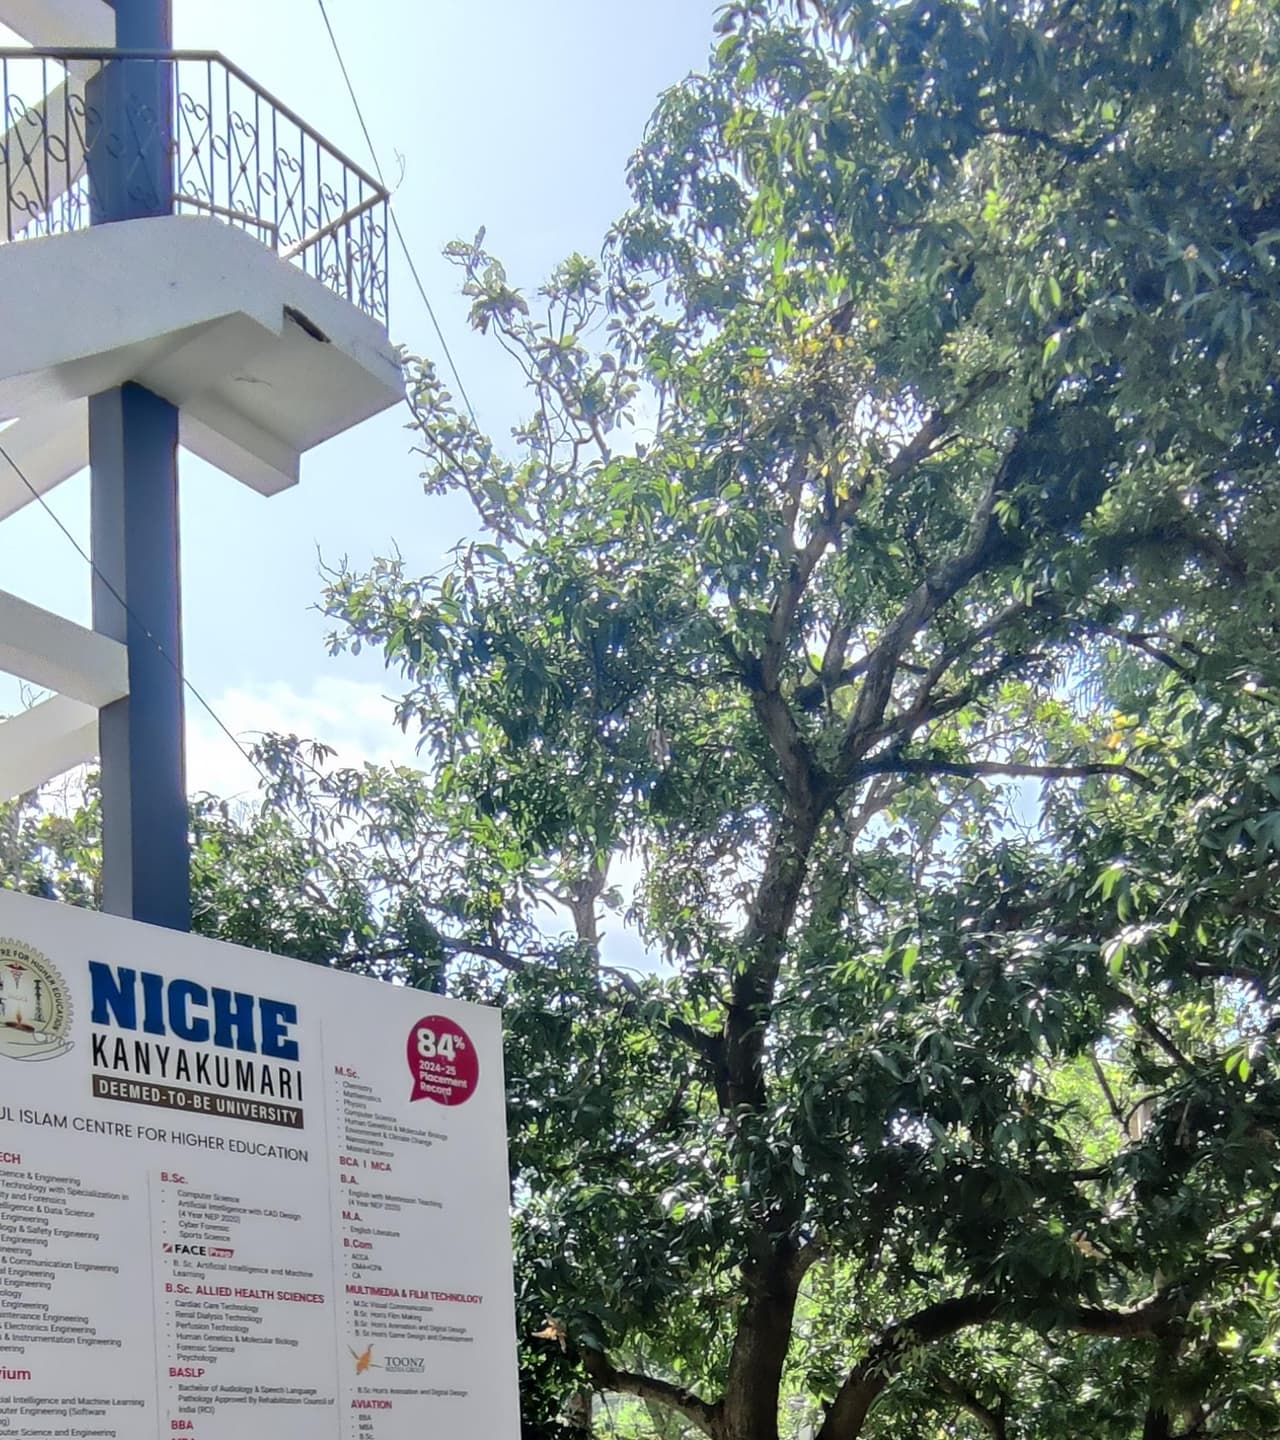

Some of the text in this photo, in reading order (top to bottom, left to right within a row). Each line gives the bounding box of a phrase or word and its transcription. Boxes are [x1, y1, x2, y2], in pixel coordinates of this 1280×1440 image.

[13, 950, 30, 961] FOR
[31, 959, 56, 986] HIGHER
[88, 960, 300, 1062] NICHE
[417, 1028, 466, 1062] 84%
[92, 1033, 303, 1102] KANYAKUMARI
[335, 1065, 360, 1079] M.Sc.
[419, 1060, 457, 1076] 2024-25
[420, 1071, 468, 1088] Placement
[420, 1081, 452, 1096] Record
[99, 1079, 297, 1124] DEEMED-TO-BE UNIVERSITY
[19, 1109, 68, 1129] ISLAM
[72, 1117, 133, 1138] CENTRE
[137, 1126, 167, 1143] FOR
[171, 1131, 225, 1151] HIGHER
[229, 1139, 308, 1163] EDUCATION
[339, 1156, 359, 1168] BCA
[371, 1161, 392, 1172] MCA
[34, 1172, 81, 1187] Engineering
[160, 1171, 188, 1184] B.Sc.
[1, 1212, 49, 1226] Engineering
[44, 1206, 63, 1215] Data
[64, 1208, 95, 1218] Science
[26, 1225, 52, 1237] Safety
[53, 1228, 100, 1241] Engineering
[1, 1234, 49, 1248] Engineering
[343, 1238, 373, 1250] B.Com
[175, 1244, 206, 1256] FACE
[9, 1256, 73, 1269] Communication
[74, 1261, 119, 1274] Engineering
[8, 1267, 56, 1280] Engineering
[4, 1278, 52, 1291] Engineering
[165, 1283, 325, 1304] B.Sc. ALLIED HEALTH SCIENCES
[345, 1284, 400, 1297] MULTIMEDIA
[409, 1289, 429, 1300] FILM
[430, 1291, 483, 1304] TECHNOLOGY
[1, 1300, 49, 1312] Engineering
[43, 1313, 89, 1325] Engineering
[4, 1322, 49, 1332] Electronics
[50, 1324, 96, 1336] Engineering
[384, 1356, 425, 1368] TOONZ
[169, 1367, 205, 1378] BASLP
[13, 1396, 60, 1407] Intelligence
[61, 1397, 77, 1405] and
[77, 1397, 111, 1405] Machine
[112, 1399, 145, 1408] Learning
[351, 1399, 393, 1409] AVIATION
[20, 1405, 68, 1417] Engineering
[69, 1407, 106, 1417] (Software
[171, 1420, 194, 1430] BBA
[54, 1428, 70, 1436] and
[71, 1428, 117, 1438] Engineering
